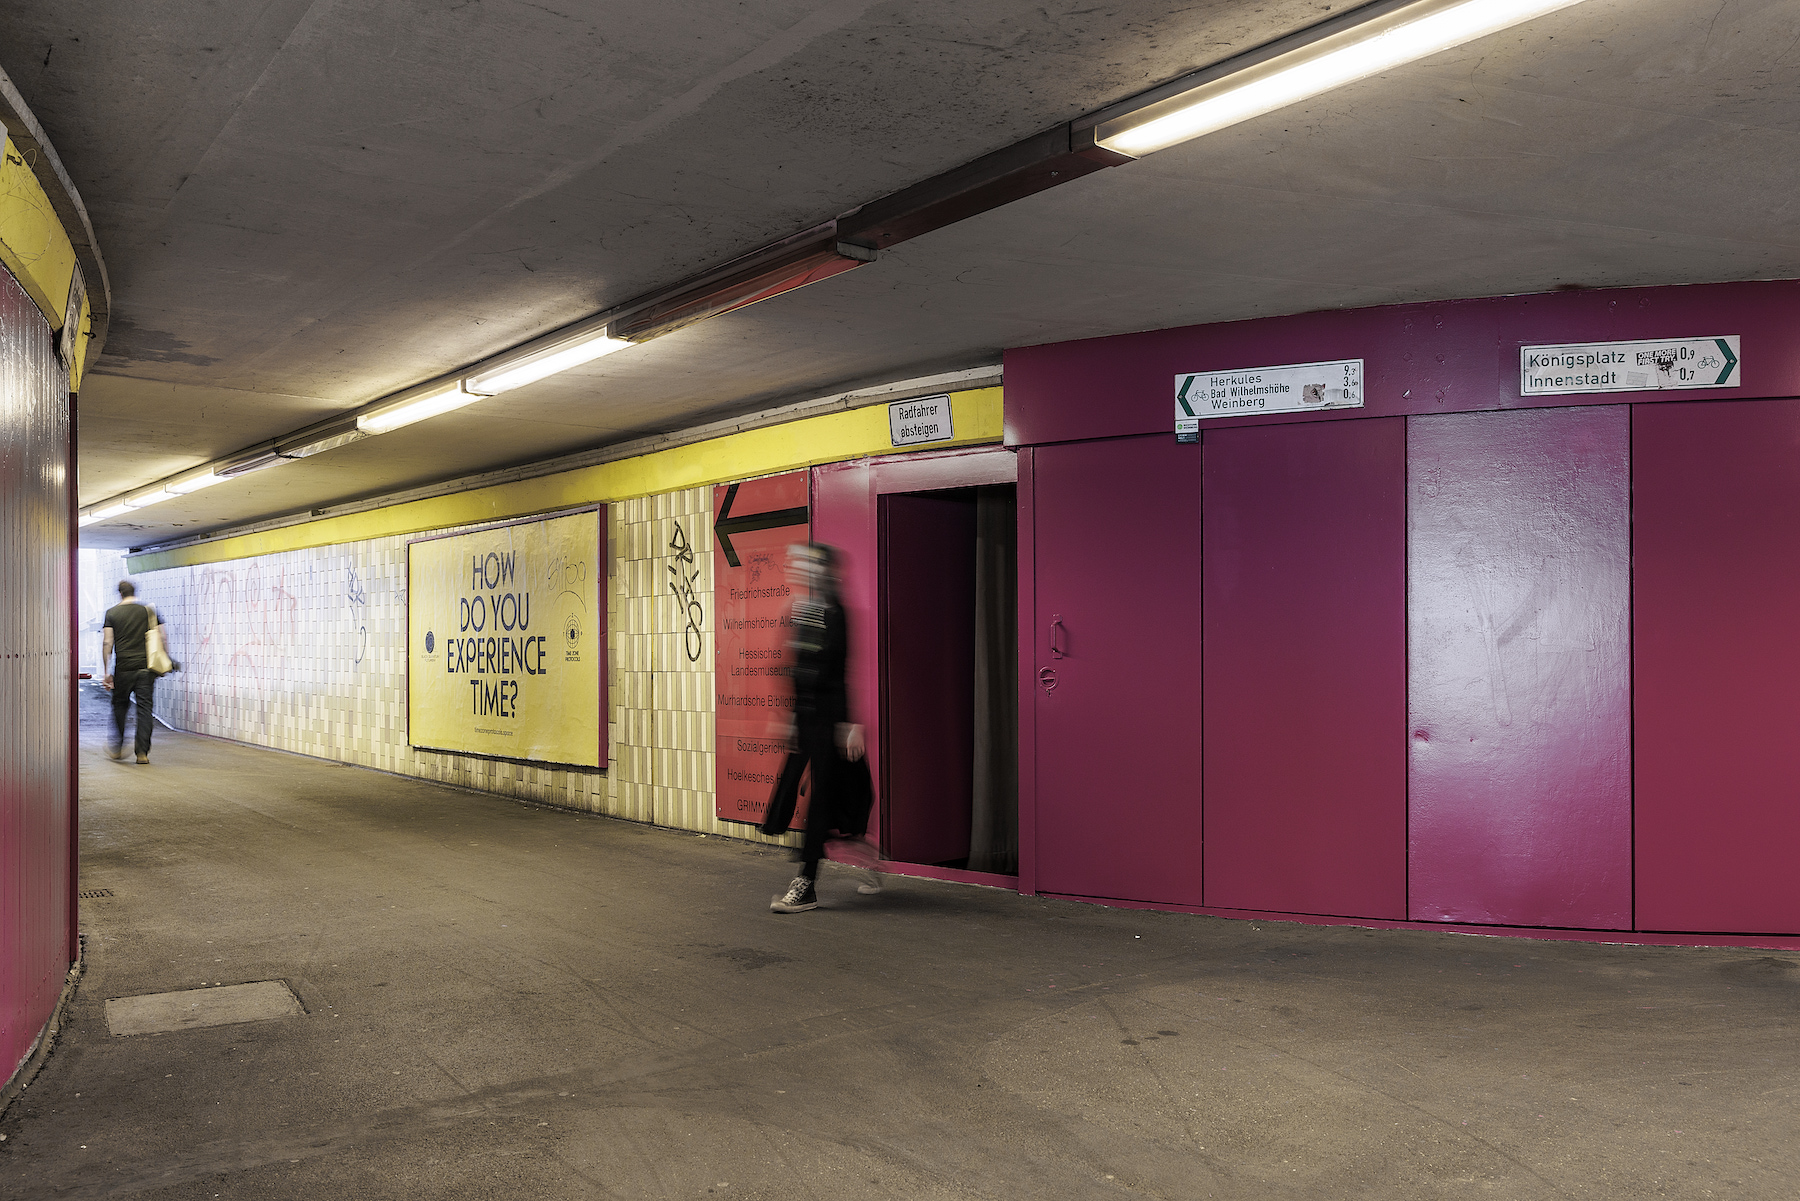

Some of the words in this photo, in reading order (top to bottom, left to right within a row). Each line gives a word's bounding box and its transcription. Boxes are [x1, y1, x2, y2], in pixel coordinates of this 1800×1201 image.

[1530, 352, 1626, 369] Königsplatz
[1680, 346, 1694, 360] 0,9
[1654, 348, 1676, 357] MORE
[1210, 374, 1262, 387] Herkules
[1530, 371, 1616, 387] Innenstadt
[1680, 367, 1694, 381] 0,7
[1210, 388, 1226, 399] Bad
[1230, 384, 1290, 397] Wilhelmshöhe
[1211, 397, 1265, 409] Weinberg
[1343, 388, 1356, 399] 0,6
[899, 404, 938, 420] Radfahrer
[900, 422, 939, 438] absteigen
[472, 550, 516, 590] HOW
[730, 585, 790, 600] Friedrichsstraße
[460, 595, 486, 632] DO
[491, 592, 530, 632] YOU
[723, 617, 777, 630] Wilhelmshöher
[447, 636, 546, 675] EXPERIENCE
[739, 648, 782, 660] Hessisches
[731, 664, 791, 676] Landesmuseum
[470, 679, 518, 718] TIME?
[718, 694, 765, 706] Murhardsche
[737, 740, 786, 756] Sozialgericht
[728, 768, 774, 784] Hoelkesches
